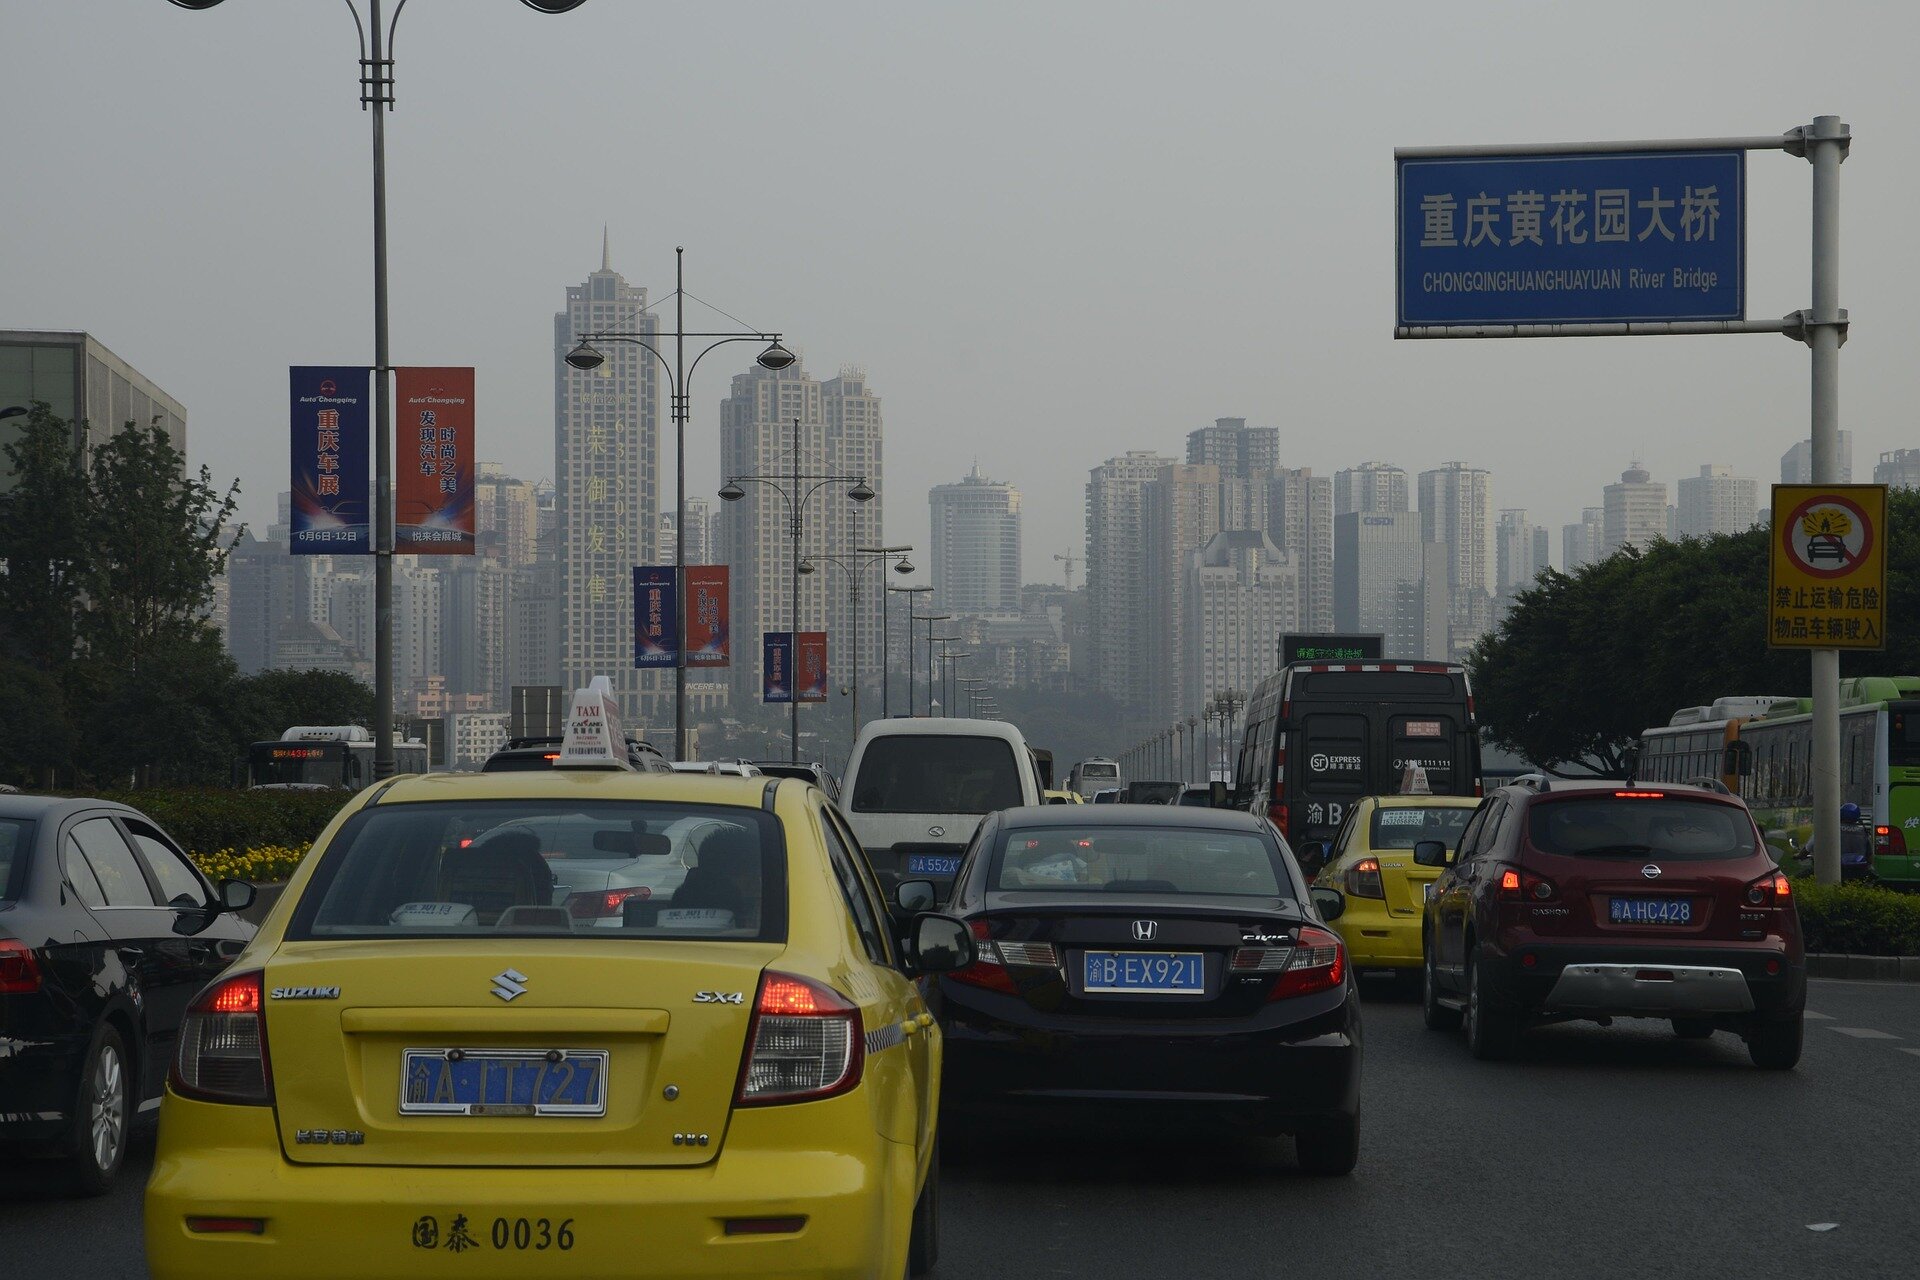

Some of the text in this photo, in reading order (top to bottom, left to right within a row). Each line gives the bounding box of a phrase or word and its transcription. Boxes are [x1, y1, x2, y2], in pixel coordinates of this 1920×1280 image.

[1420, 185, 1720, 247] 重庆黄花园大桥
[1422, 267, 1717, 292] CHONGQINGHUANGHUAYUAN River Bridge
[299, 395, 358, 405] Auto Chongqing
[427, 396, 465, 405] Chongqing
[317, 408, 339, 496] 重庆车展
[420, 410, 436, 477] 发现汽车
[440, 427, 456, 494] 时尚之美
[299, 531, 357, 542] 6月6日-12日
[412, 531, 463, 542] 悦来会展城
[1776, 586, 1879, 609] 禁止运输危险
[1775, 616, 1879, 640] 物品车辆驶入
[576, 705, 600, 717] TAXI
[1307, 803, 1356, 825] 渝B
[1532, 908, 1570, 917] QASHQAI
[1611, 901, 1691, 920] 渝A·HC428
[1089, 958, 1195, 984] 渝B·EX921
[271, 986, 340, 1000] SUZUKI
[692, 991, 744, 1004] SX4
[491, 1217, 575, 1251] 0036
